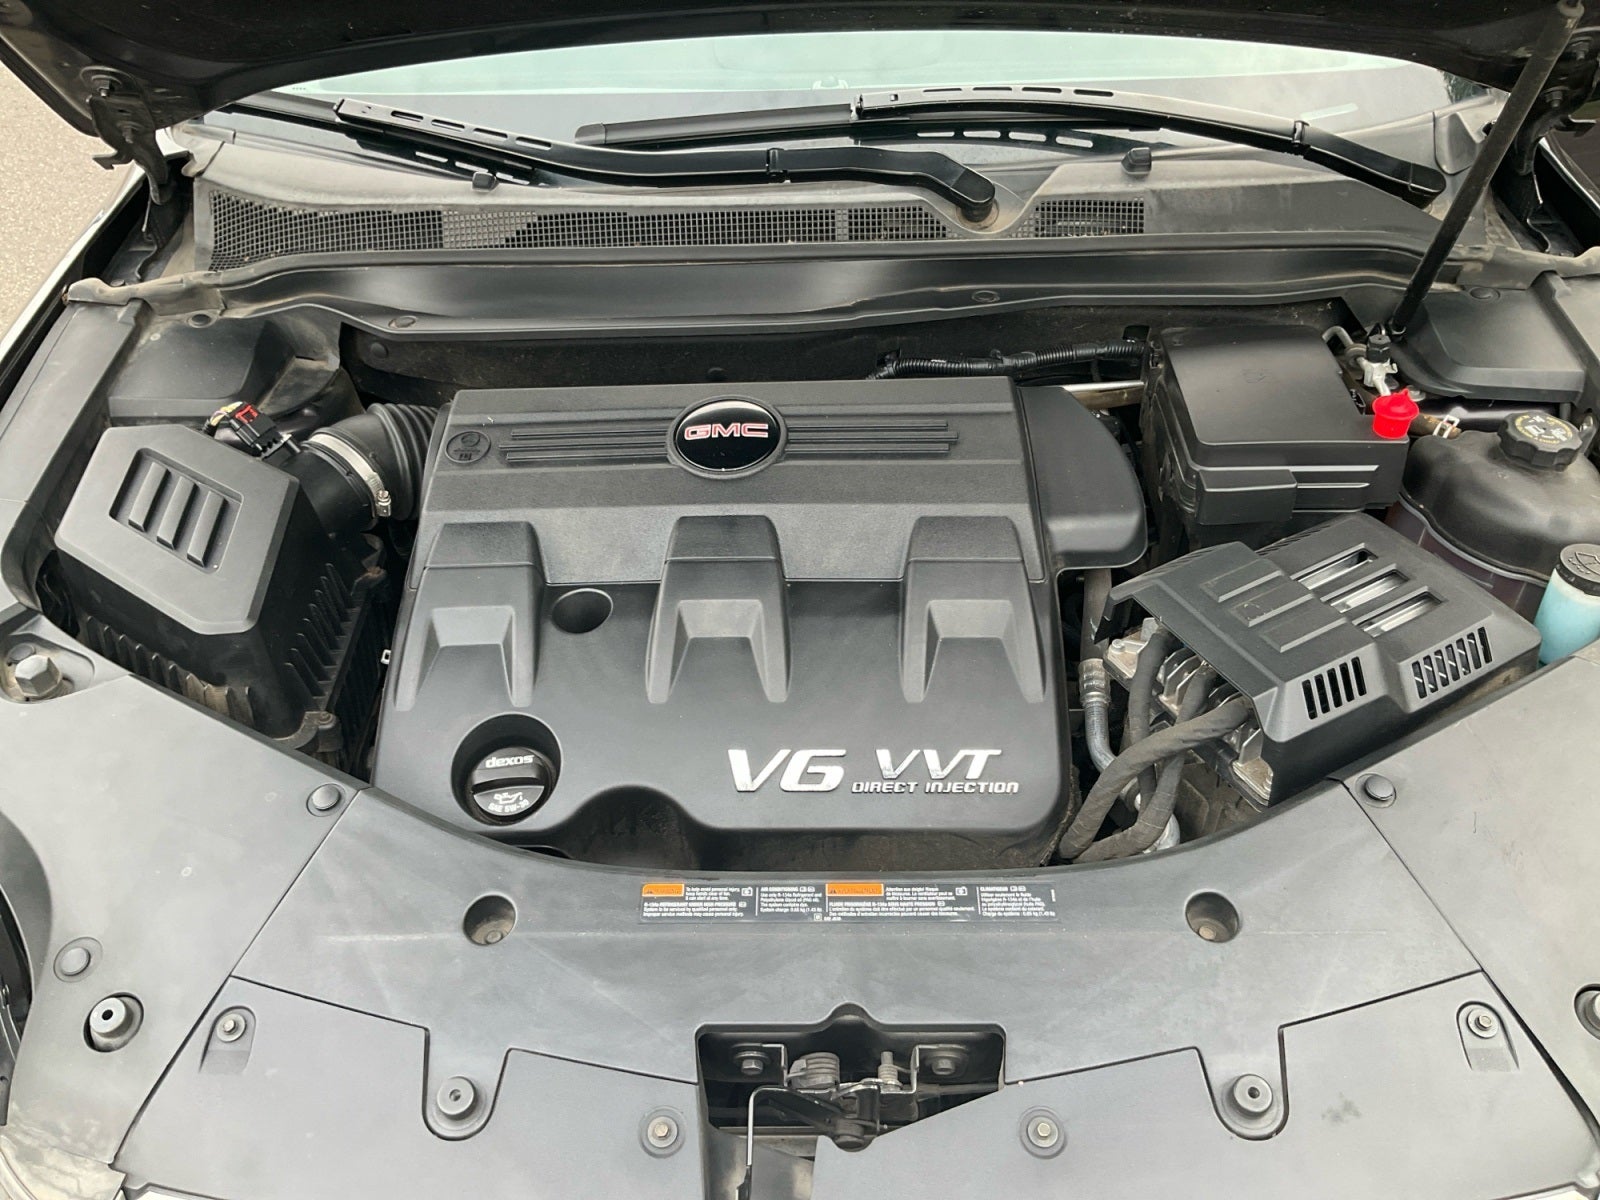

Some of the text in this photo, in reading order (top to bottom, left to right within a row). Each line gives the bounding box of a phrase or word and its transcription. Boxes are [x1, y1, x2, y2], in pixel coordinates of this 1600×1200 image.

[684, 423, 768, 440] GMC
[485, 755, 534, 768] dexos
[876, 749, 1001, 779] VVT
[728, 750, 846, 791] V6
[852, 781, 1019, 793] DIRECT INJECTION
